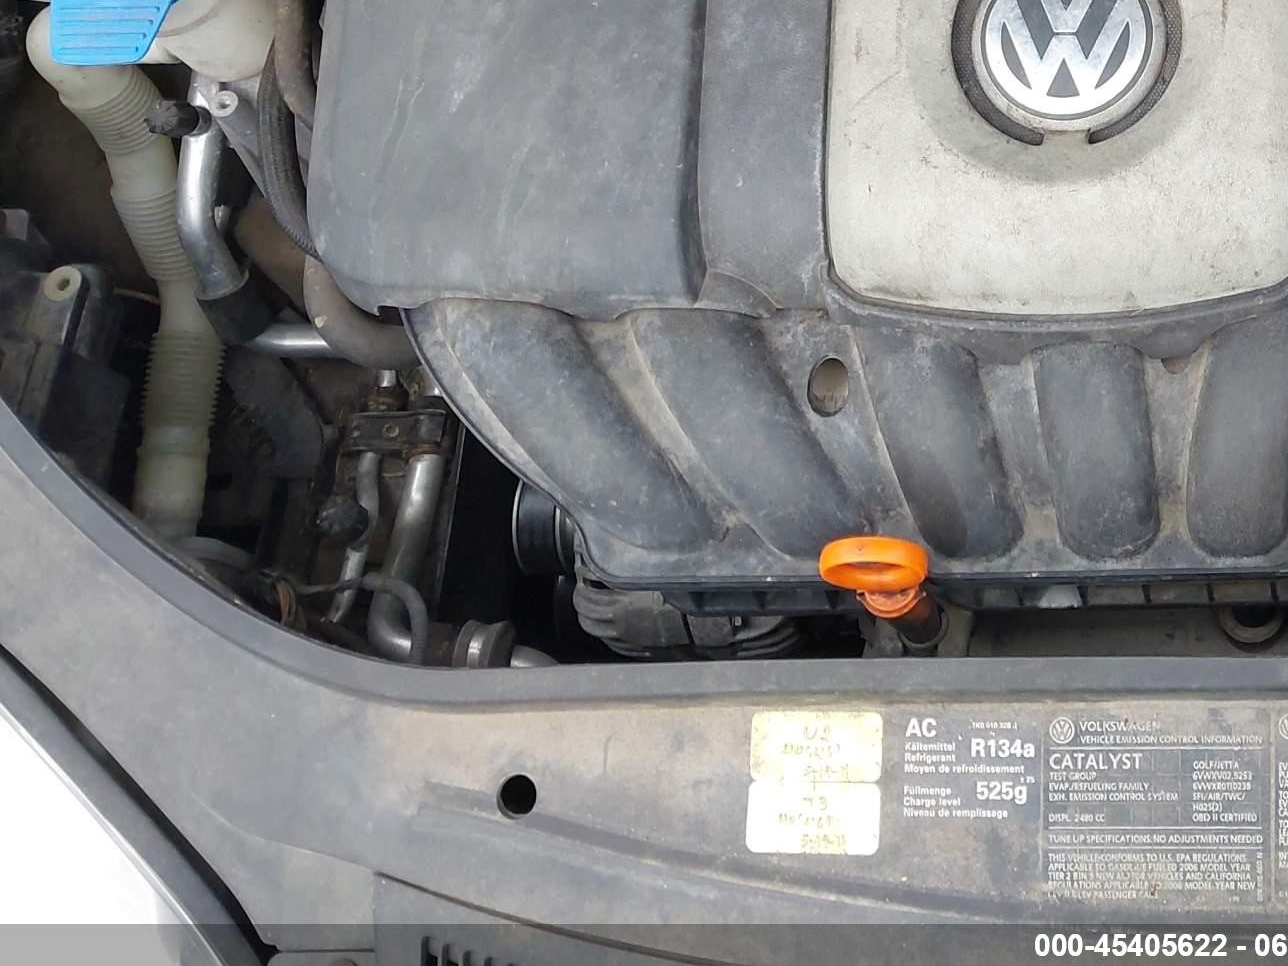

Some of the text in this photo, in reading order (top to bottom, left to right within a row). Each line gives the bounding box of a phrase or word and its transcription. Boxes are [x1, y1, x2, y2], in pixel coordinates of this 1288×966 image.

[905, 718, 937, 738] AC
[1079, 721, 1161, 732] VOLKSWAGEN
[1080, 735, 1263, 744] VEHICLE EMISSION CONTROL INFORMATION
[970, 738, 1036, 758] R134a
[904, 753, 956, 764] Refrigerant
[1049, 753, 1143, 770] CATALYST
[904, 764, 936, 775] Moyen
[938, 764, 950, 774] de
[1049, 772, 1097, 780] TEST GROUP
[1118, 782, 1149, 791] FAMILY
[976, 781, 1028, 805] 525g
[1069, 793, 1107, 801] EMISSION
[1109, 793, 1145, 801] CONTROL
[1147, 793, 1178, 801] SYSTEM
[1279, 791, 1288, 799] TO
[903, 797, 961, 808] Charge level
[903, 808, 1009, 820] Niveau de remplissage
[1095, 813, 1105, 822] CC
[1192, 813, 1210, 822] OBD
[1220, 813, 1257, 822] CERTIFIED
[1279, 820, 1288, 828] TO
[1049, 835, 1070, 843] TUNE
[1072, 835, 1084, 843] UP
[1153, 835, 1166, 843] NO
[1168, 835, 1228, 843] ADJUSTMENTS
[1230, 835, 1263, 843] NEEDED
[1048, 853, 1065, 862] THIS
[1146, 853, 1157, 862] TO
[1176, 853, 1190, 862] EPA
[1193, 853, 1247, 862] REGULATIONS
[1200, 863, 1227, 871] MODEL
[1230, 863, 1251, 871] YEAR
[1048, 873, 1065, 881] TIER
[1185, 873, 1202, 881] AND
[1204, 873, 1251, 881] CALIFORNIA
[1184, 882, 1211, 890] MODEL
[1214, 882, 1235, 890] YEAR
[1237, 882, 1256, 890] NEW
